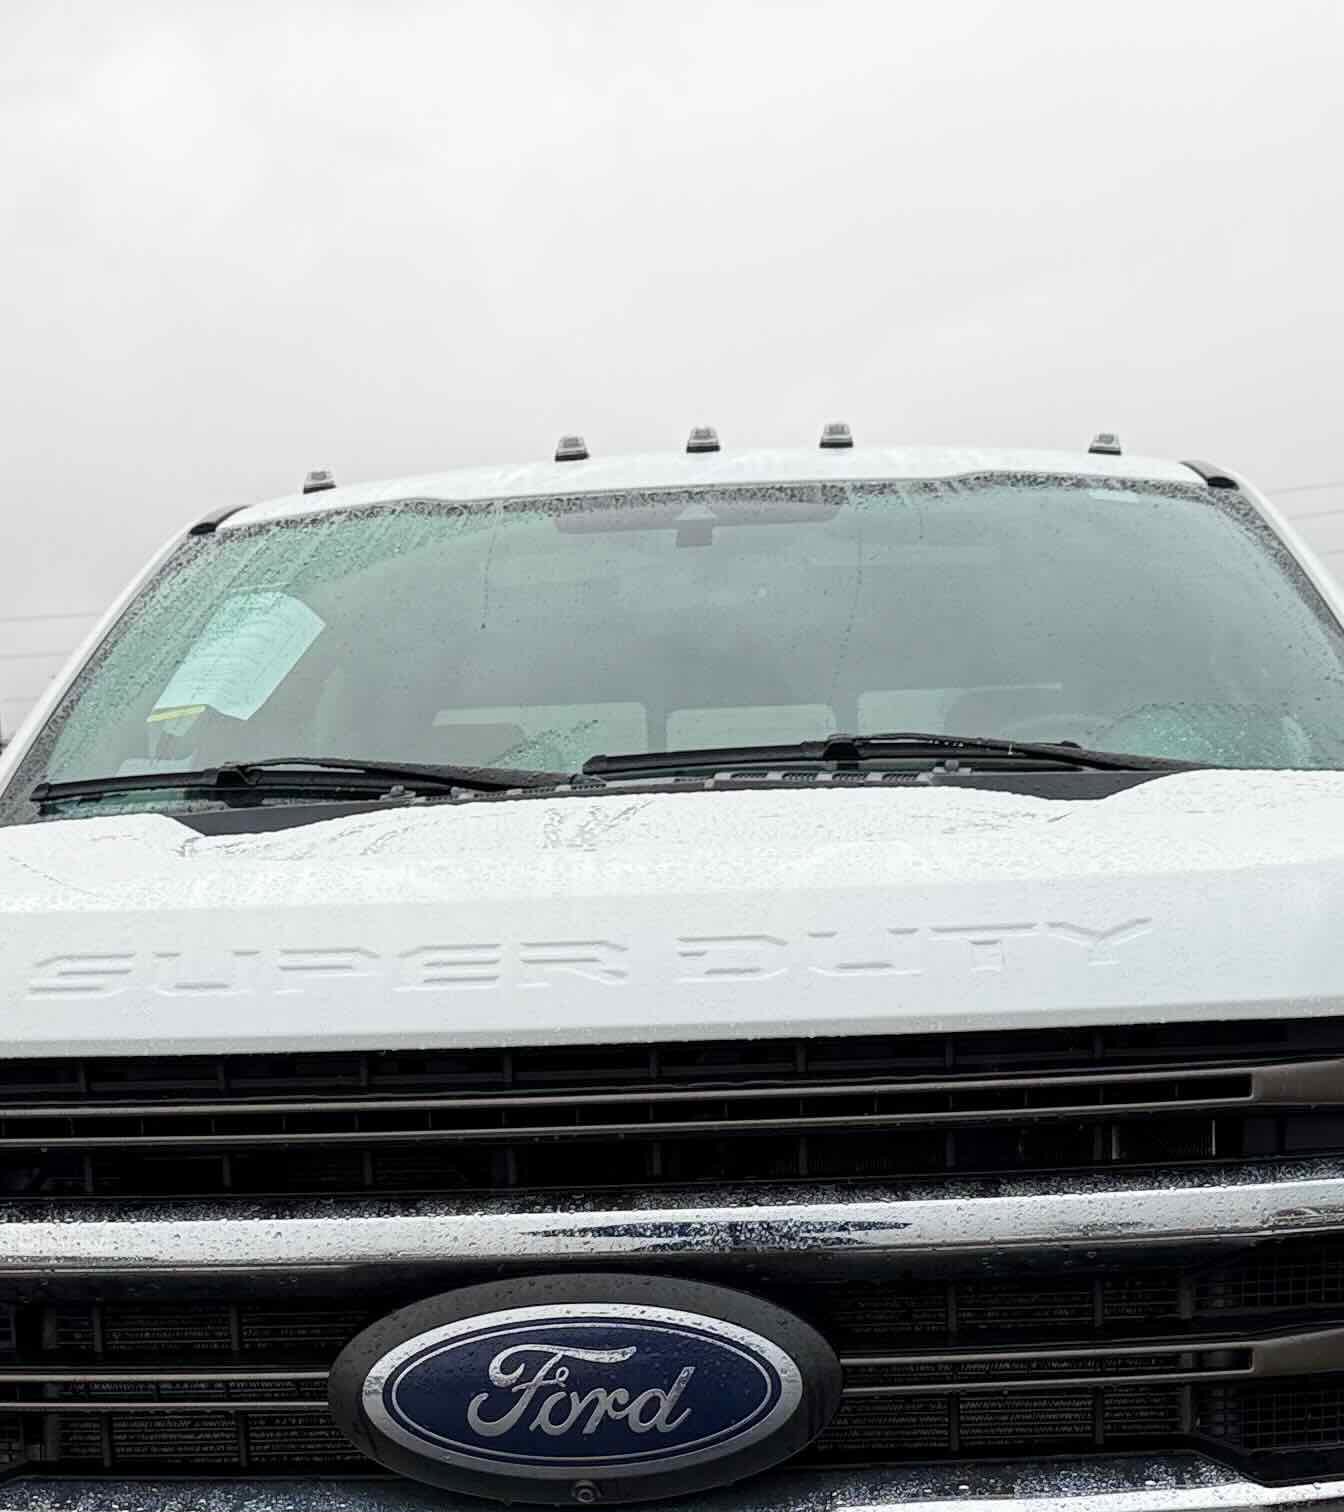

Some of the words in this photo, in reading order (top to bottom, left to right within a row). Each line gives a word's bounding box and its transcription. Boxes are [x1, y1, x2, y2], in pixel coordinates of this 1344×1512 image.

[27, 939, 628, 1001] SUPER
[674, 916, 1153, 983] DUTY
[466, 1343, 696, 1437] Ford
